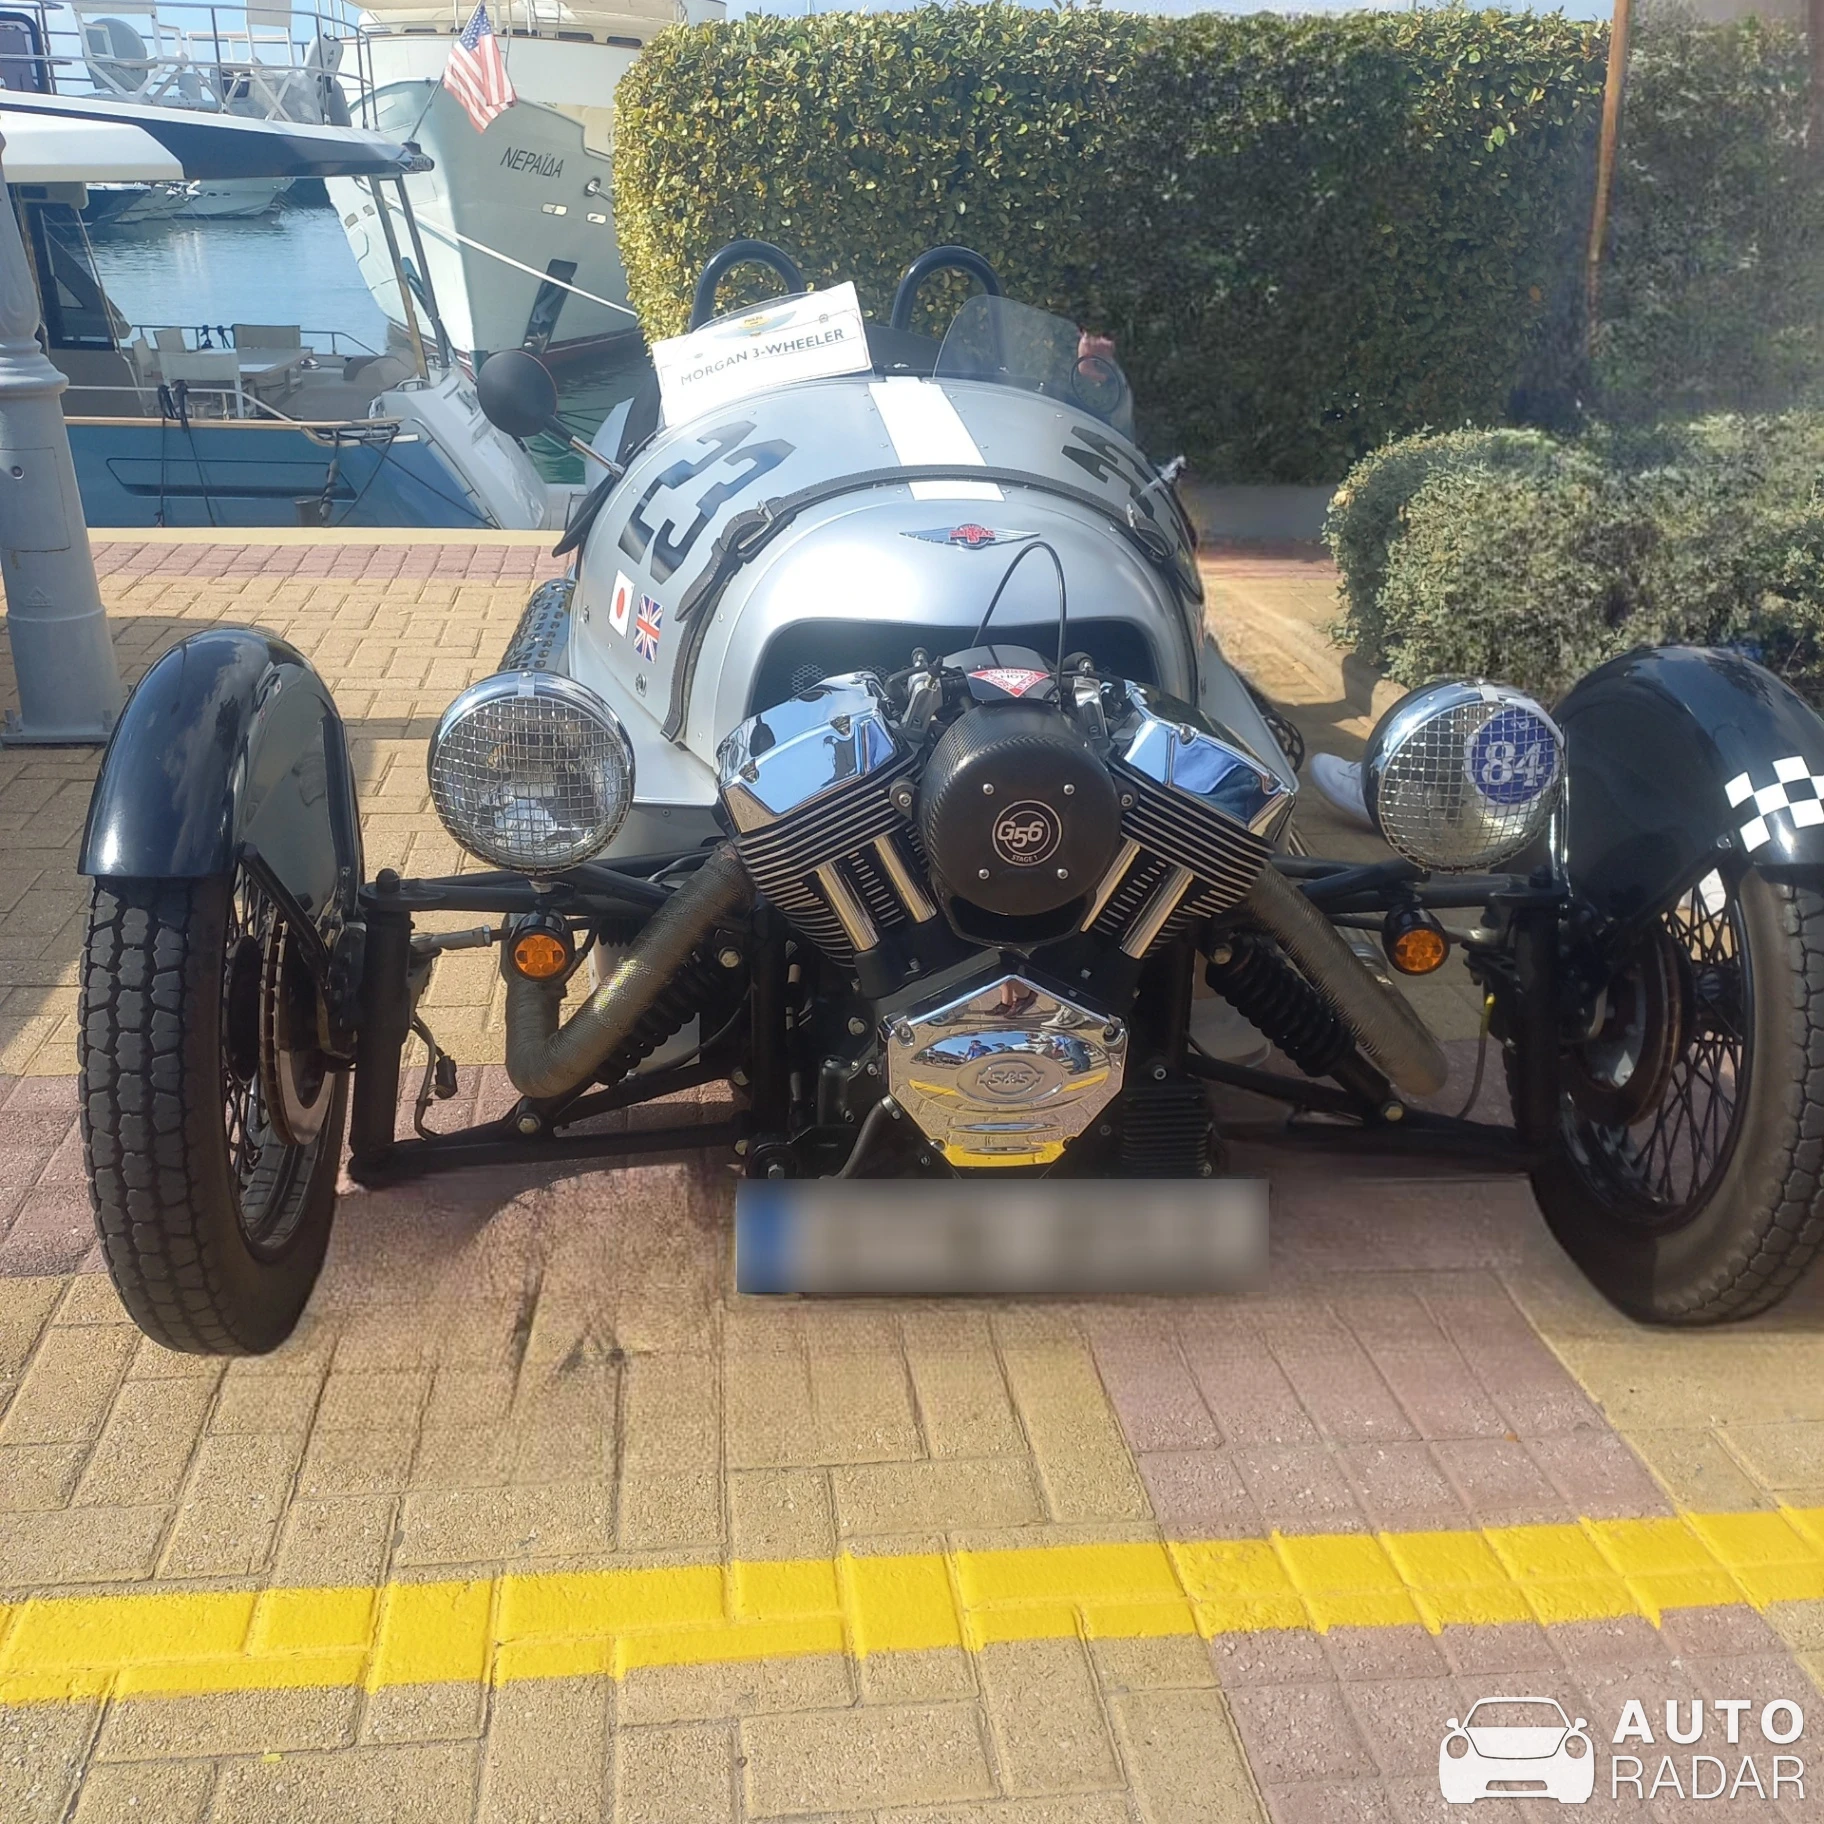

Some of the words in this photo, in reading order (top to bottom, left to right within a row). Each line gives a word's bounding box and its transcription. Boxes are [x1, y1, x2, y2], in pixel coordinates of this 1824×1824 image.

[680, 350, 748, 386] MORGAN
[752, 328, 845, 359] 3-WHEELER
[618, 420, 797, 585] 23
[1481, 741, 1545, 787] 84
[997, 820, 1045, 848] G56
[1011, 854, 1033, 863] STAGE
[991, 1071, 1033, 1085] S&S
